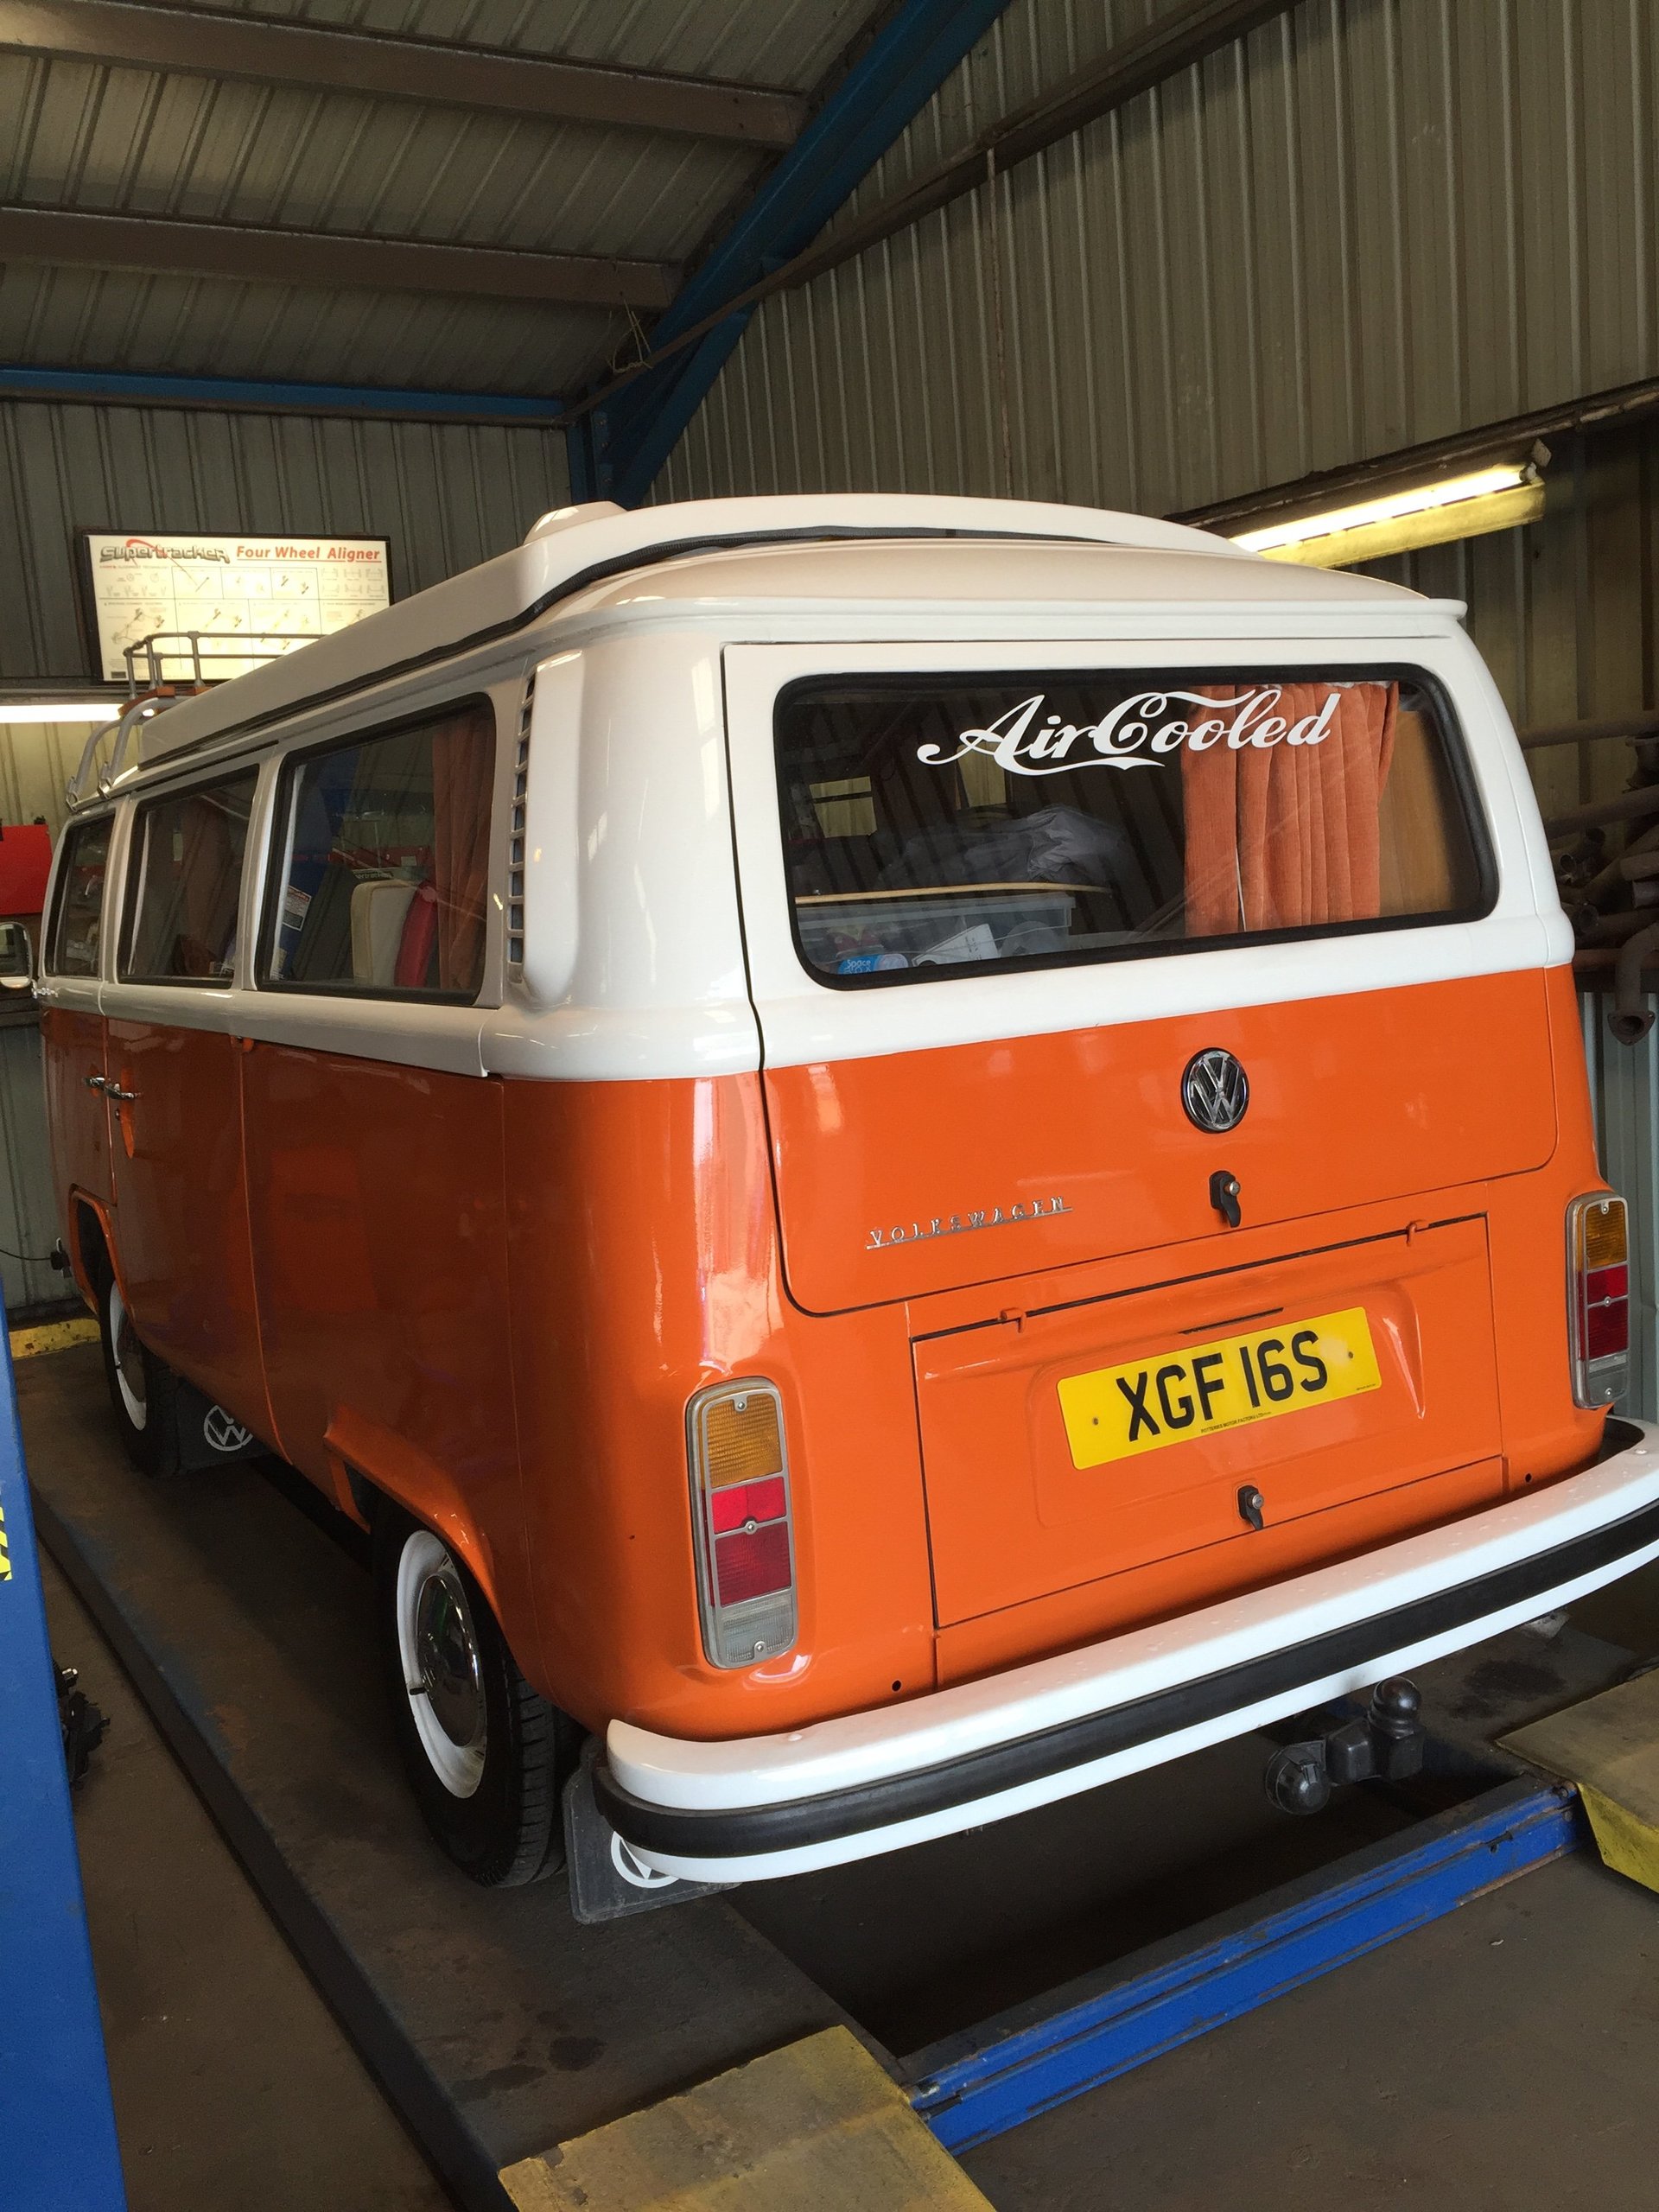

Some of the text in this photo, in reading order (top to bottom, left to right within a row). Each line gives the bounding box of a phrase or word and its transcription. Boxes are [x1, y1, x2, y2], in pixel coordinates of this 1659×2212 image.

[236, 545, 380, 563] Four Wheel Aligner
[846, 959, 872, 970] Space
[868, 1196, 1065, 1247] VOLKSWAGEN
[1116, 1330, 1328, 1442] XGF 16S
